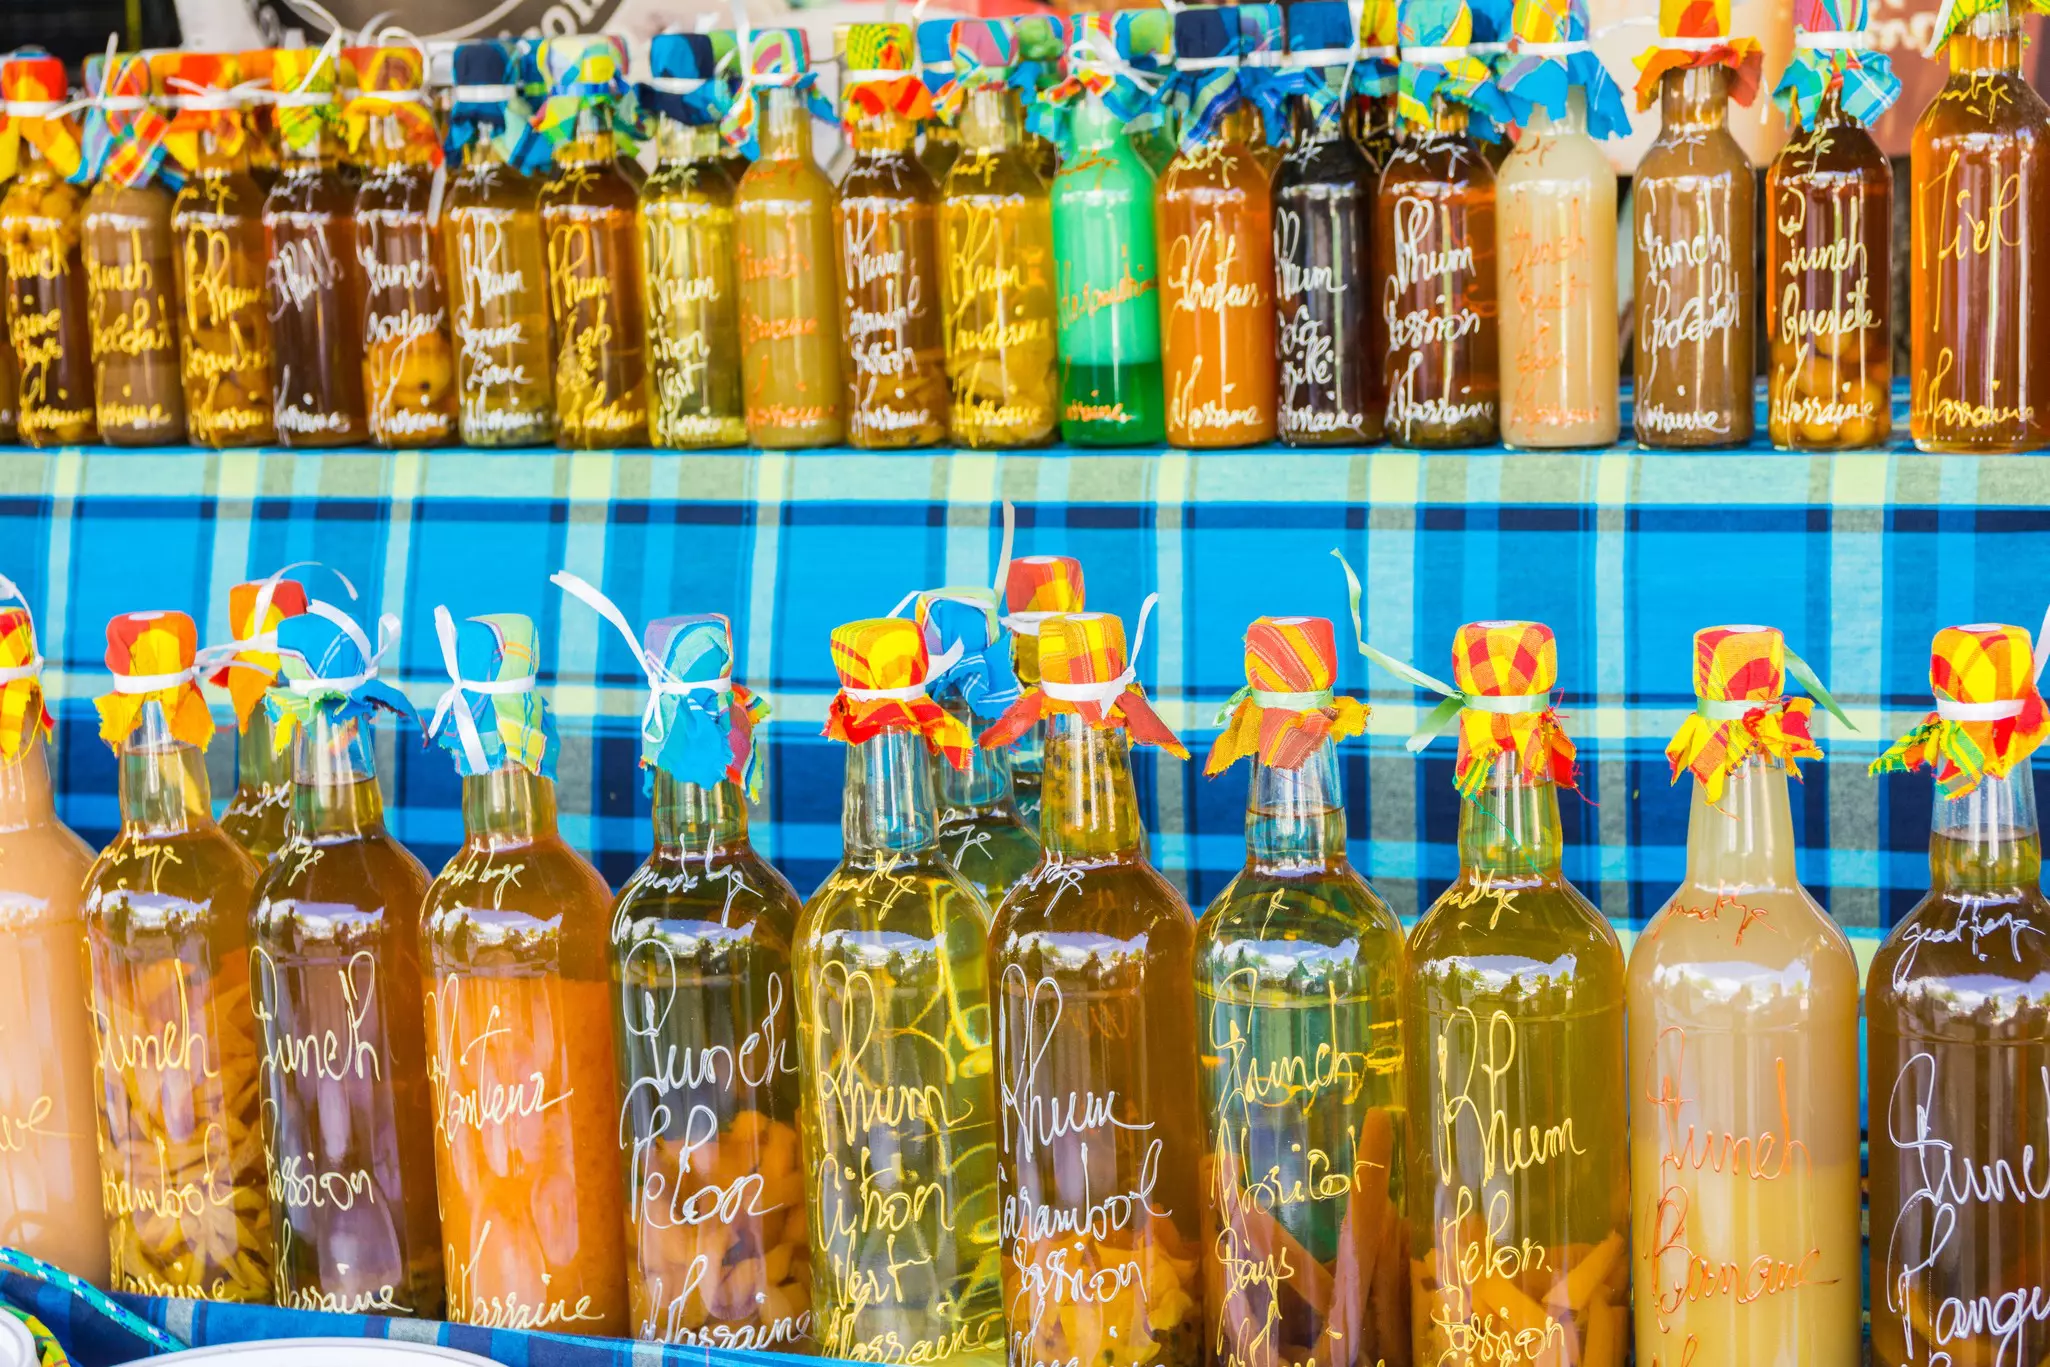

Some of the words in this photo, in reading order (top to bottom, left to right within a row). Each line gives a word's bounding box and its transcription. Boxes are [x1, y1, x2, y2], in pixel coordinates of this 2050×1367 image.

[459, 208, 528, 320] Rhum
[549, 224, 612, 321] Rhum
[646, 220, 720, 320] Rhum
[845, 197, 903, 289] Rhum
[1395, 196, 1476, 294] Rhum
[1637, 176, 1728, 284] Punch
[250, 946, 381, 1082] Punch
[623, 939, 798, 1096] Punch
[815, 960, 974, 1152] Rhum
[999, 963, 1155, 1162] Rhum
[1210, 967, 1354, 1103] Punch
[260, 1098, 374, 1211] Passion
[1437, 1006, 1586, 1187] Rhum
[1646, 1027, 1812, 1181] Punch
[835, 1230, 931, 1311] Vert
[1652, 1185, 1841, 1314] Banane
